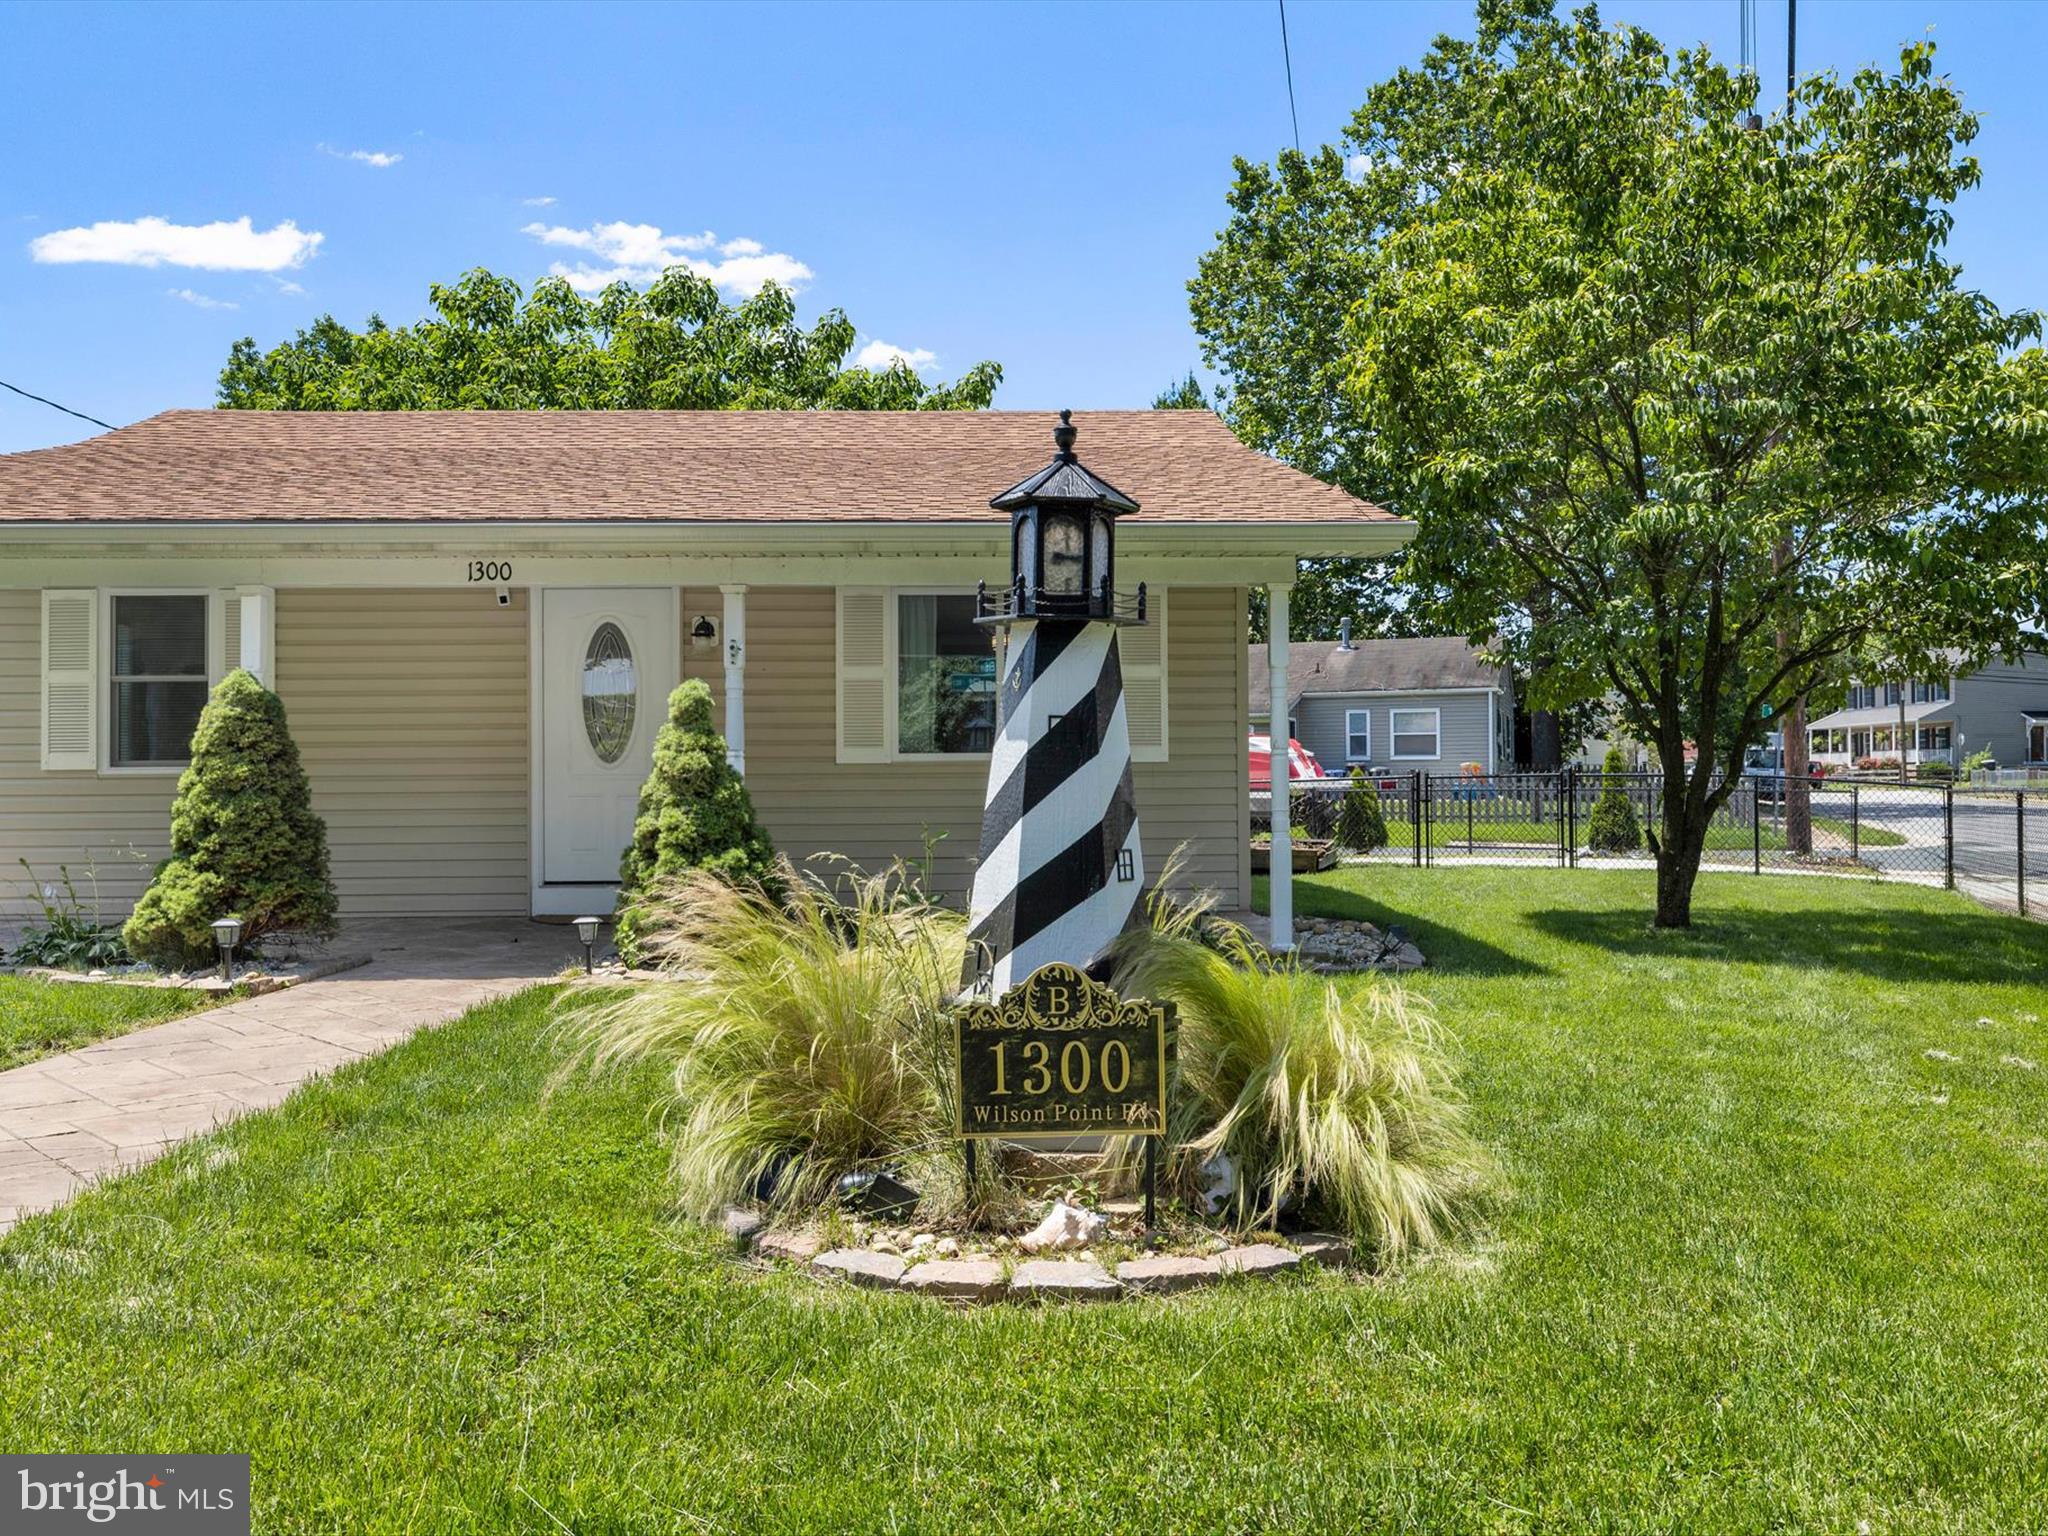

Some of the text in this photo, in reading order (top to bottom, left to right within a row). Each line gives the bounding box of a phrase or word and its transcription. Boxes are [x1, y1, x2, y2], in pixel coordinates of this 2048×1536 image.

[468, 561, 512, 582] 1300
[1049, 986, 1070, 1015] B
[989, 1039, 1131, 1095] 1300
[973, 1105, 1045, 1123] Wilson
[1054, 1103, 1113, 1122] Point
